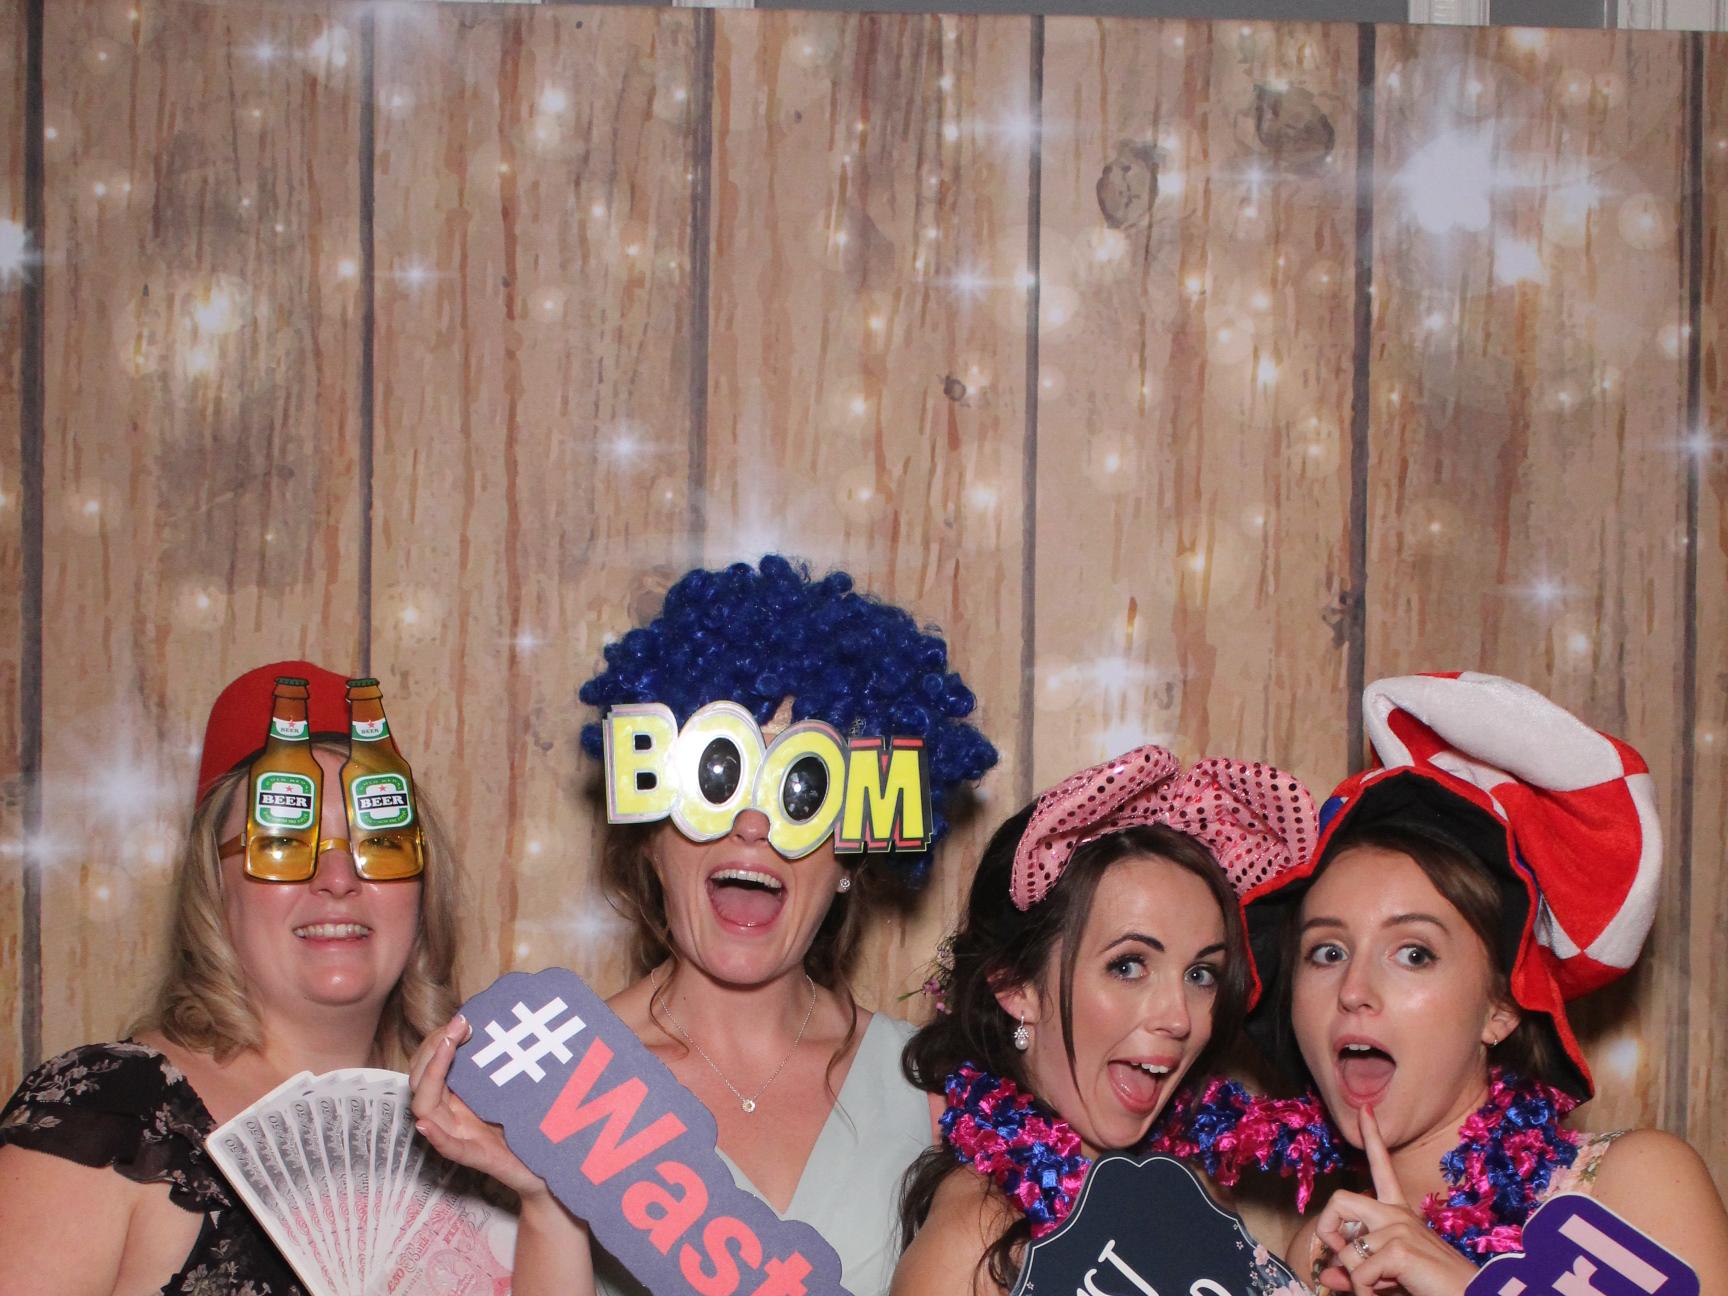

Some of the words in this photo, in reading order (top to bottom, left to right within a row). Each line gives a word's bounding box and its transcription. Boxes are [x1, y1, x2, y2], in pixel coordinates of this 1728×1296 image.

[603, 700, 934, 860] BOOM
[262, 794, 308, 808] BEER
[360, 795, 404, 809] BEER
